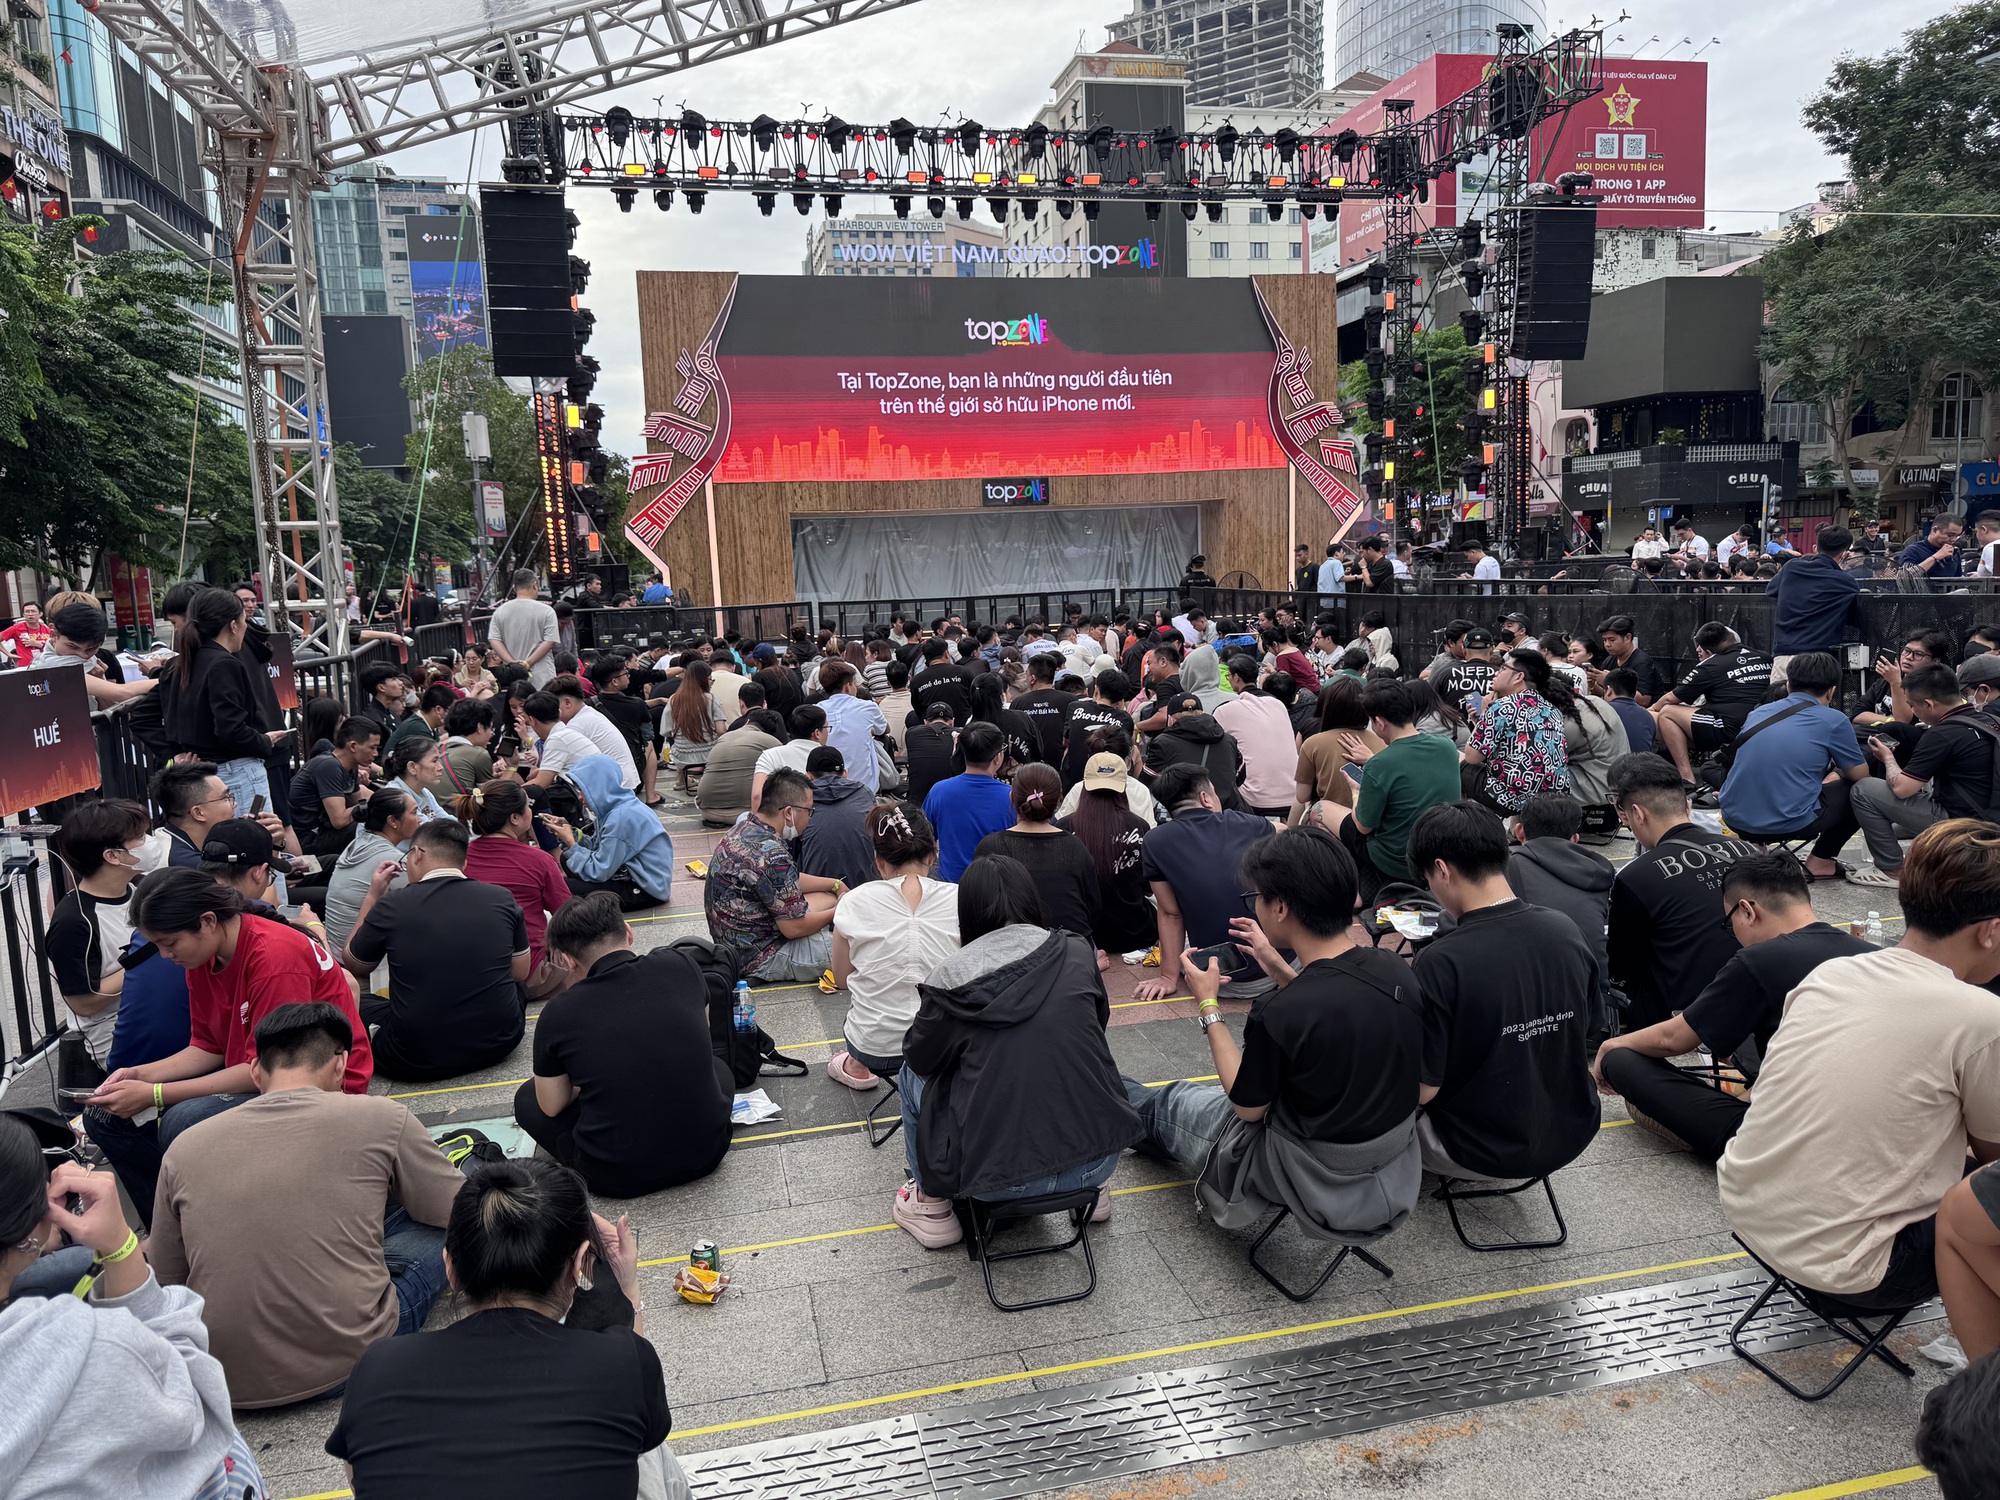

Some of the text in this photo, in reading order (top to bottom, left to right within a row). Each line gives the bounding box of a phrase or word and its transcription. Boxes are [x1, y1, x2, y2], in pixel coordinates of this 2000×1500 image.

[1113, 62, 1149, 77] SAIGON
[1619, 71, 1636, 79] QUỐC
[1647, 72, 1655, 80] VỀ
[1655, 72, 1667, 80] DÂN
[0, 105, 36, 153] THE
[36, 131, 69, 173] ONE
[1575, 162, 1664, 172] MỌI DỊCH VỤ TIỆN ÍCH
[1595, 179, 1633, 190] TRONG
[1636, 179, 1641, 190] 1
[1644, 179, 1666, 190] APP
[1623, 193, 1635, 204] TỜ
[1636, 192, 1667, 204] TRUYỀN
[1667, 193, 1697, 204] THỐNG
[839, 221, 944, 231] HARBOUR VIEW TOWER
[840, 243, 896, 262] WOW
[902, 240, 946, 267] VIỆT
[952, 245, 1004, 264] NAM.
[1007, 242, 1071, 264] QUÀO!
[837, 366, 1173, 394] Tại TopZone, bạn là những người đầu tiên
[879, 393, 1136, 417] trên thế giới sở hữu iPhone mới.
[1728, 473, 1768, 485] CHUA
[1899, 468, 1941, 485] KATINAT
[1579, 483, 1607, 495] CHUA
[1452, 666, 1495, 679] NEED
[1072, 707, 1123, 728] Brooklyn
[33, 717, 61, 748] HUẾ
[1501, 1023, 1525, 1037] 2023
